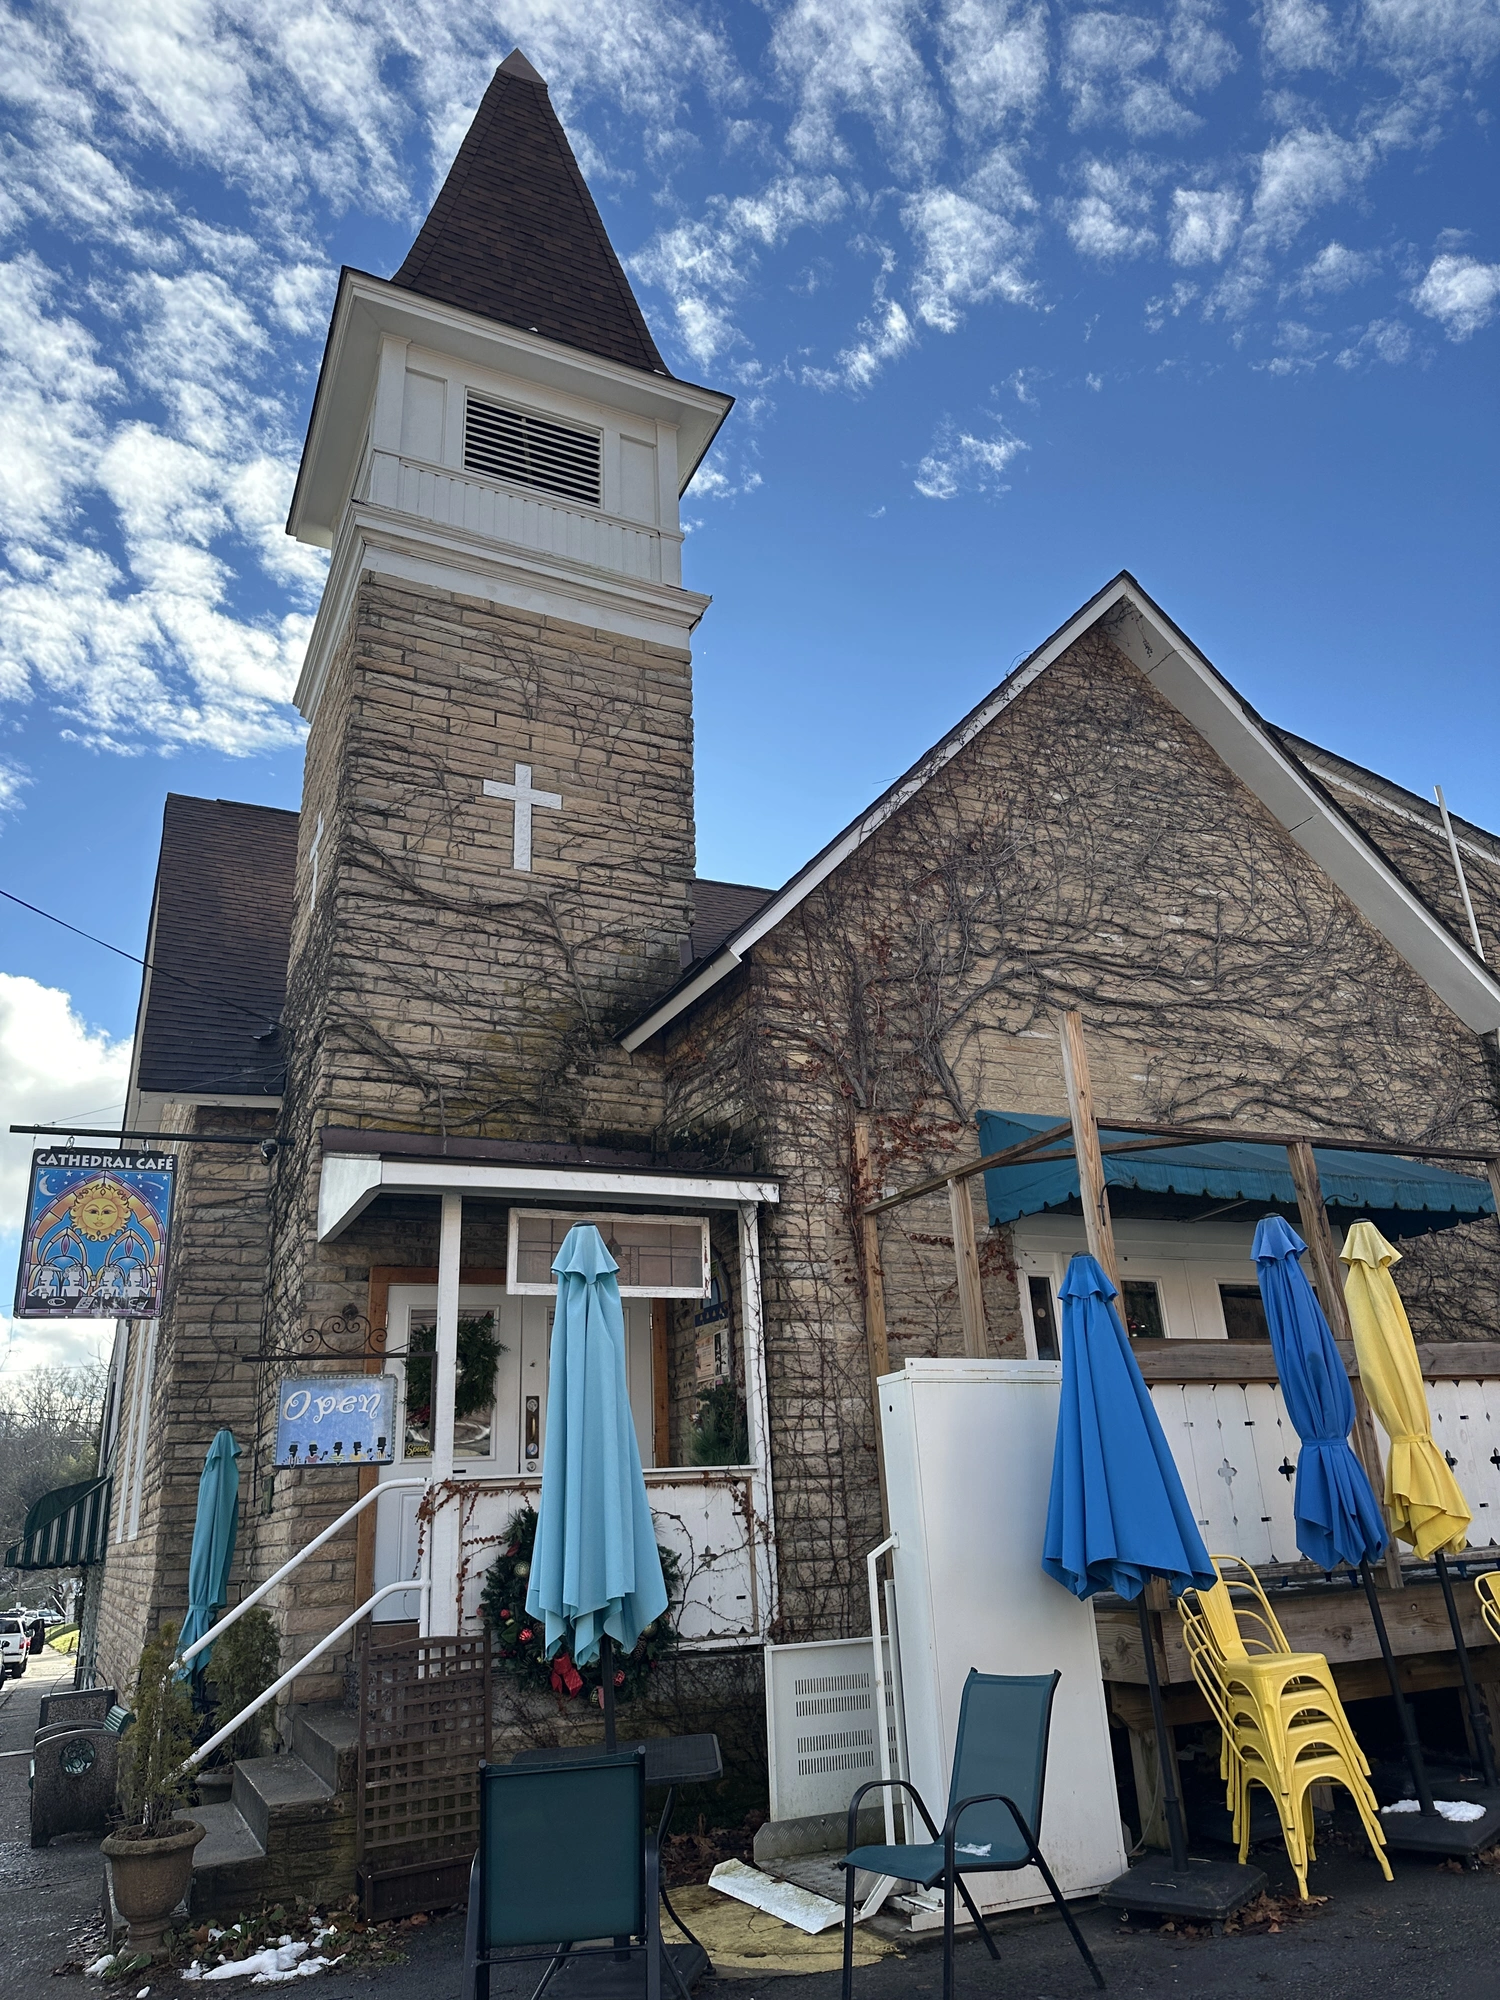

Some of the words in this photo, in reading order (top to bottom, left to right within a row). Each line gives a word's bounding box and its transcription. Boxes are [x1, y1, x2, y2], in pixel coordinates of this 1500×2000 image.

[36, 1153, 133, 1169] CATHEDRAL
[136, 1156, 174, 1170] CAFÉ
[283, 1390, 380, 1423] Open
